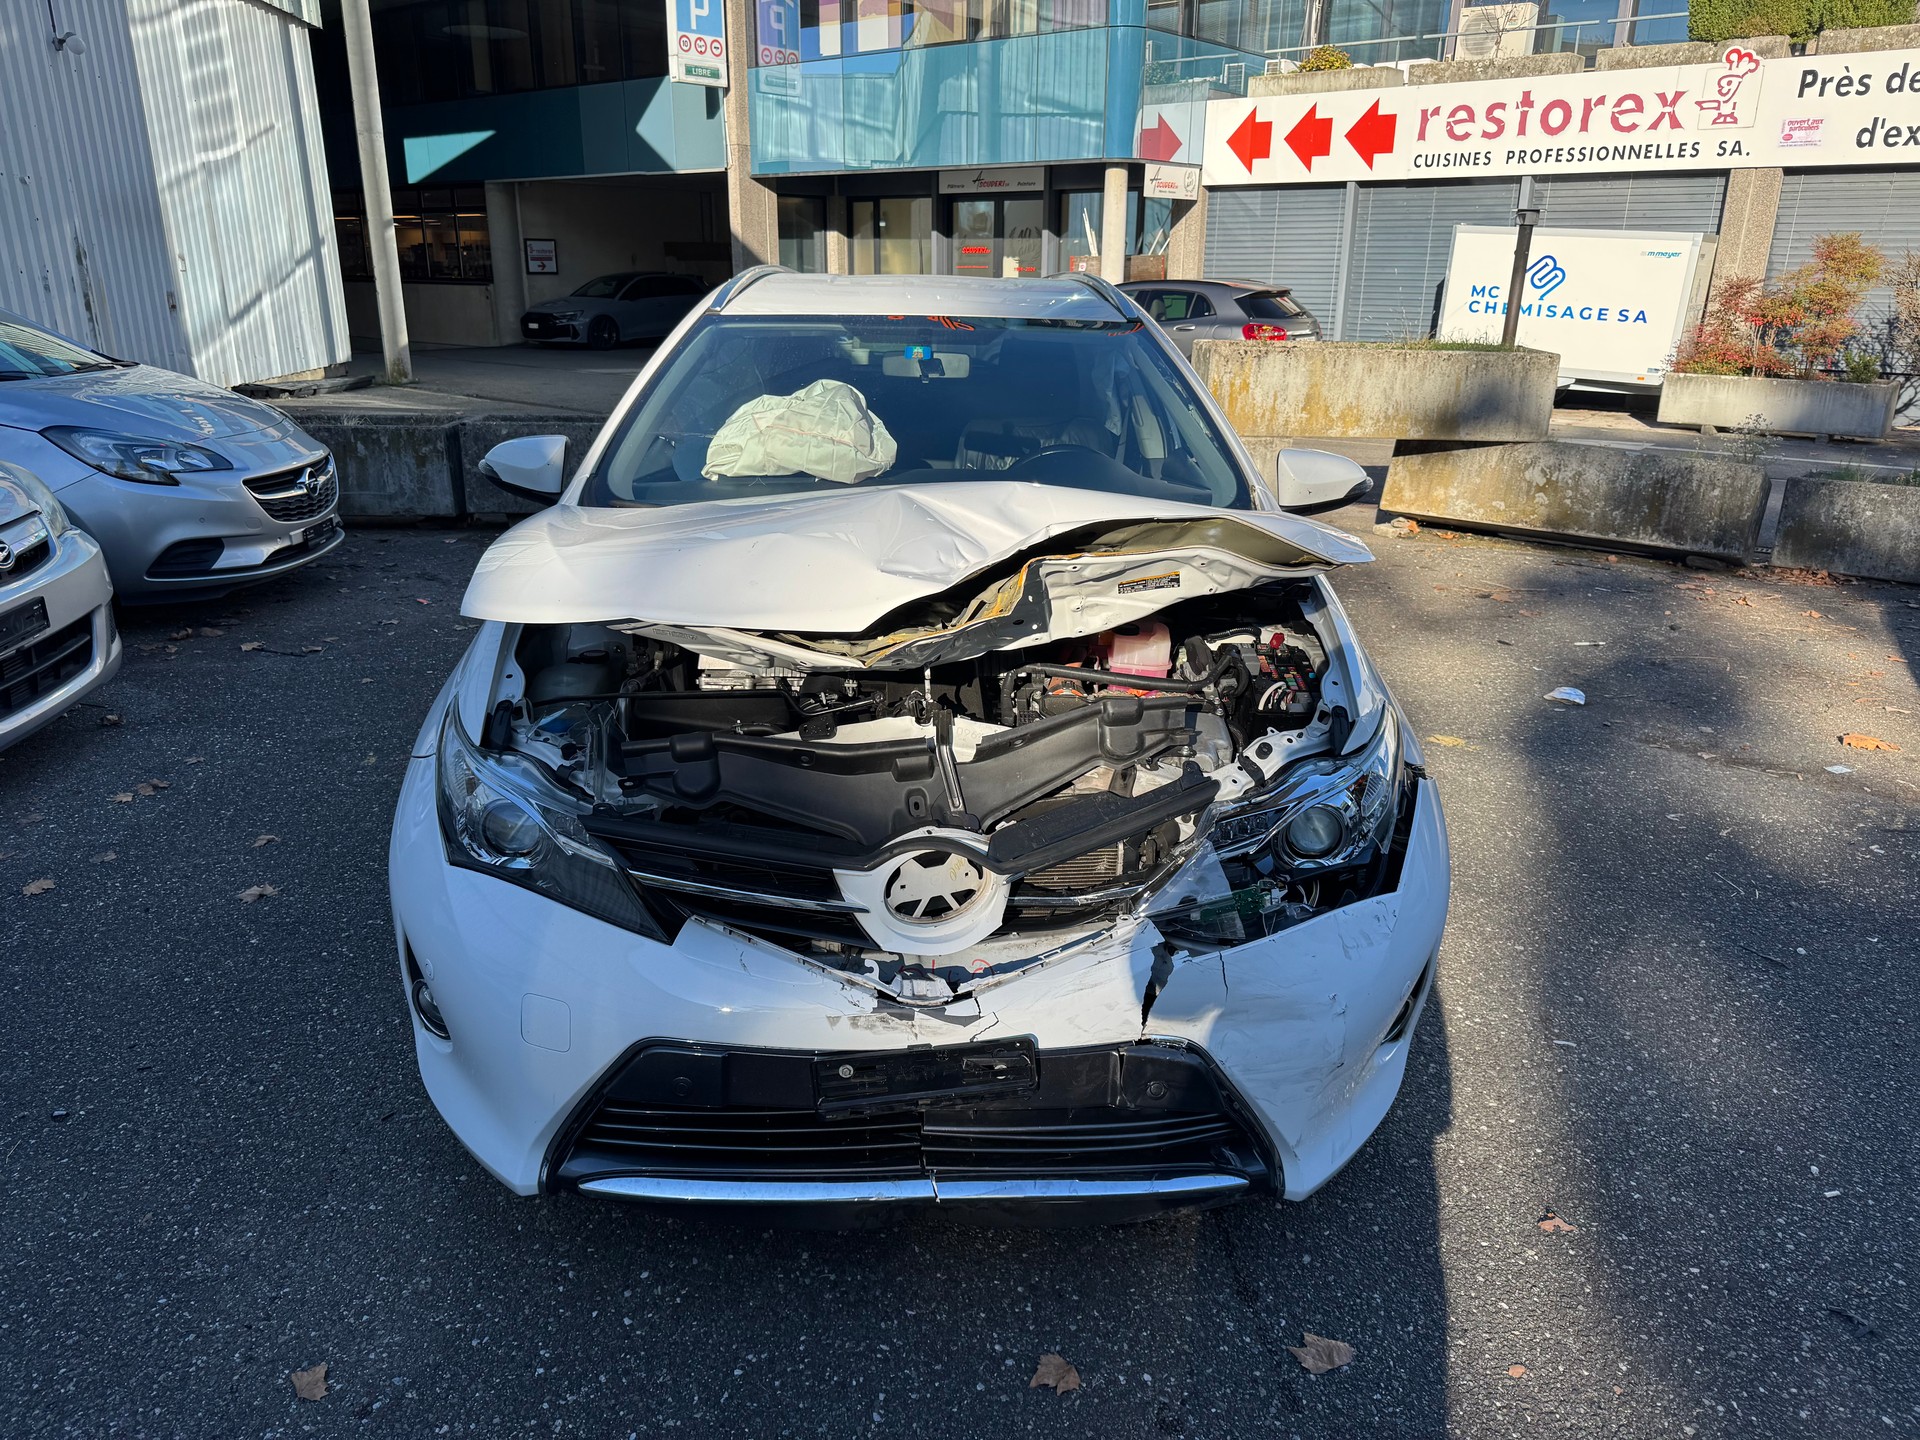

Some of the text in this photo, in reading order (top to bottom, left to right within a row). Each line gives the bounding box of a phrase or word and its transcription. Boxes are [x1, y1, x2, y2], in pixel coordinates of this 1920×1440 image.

[689, 0, 709, 30] P
[682, 40, 689, 48] 10
[692, 67, 712, 77] LIBRE
[1797, 66, 1873, 98] Près
[1416, 90, 1690, 142] restorex
[1787, 118, 1810, 126] ouvert
[1855, 116, 1920, 149] d'ex
[1413, 140, 1751, 169] CUISINES PROFESSIONNELLES SA.
[1470, 285, 1500, 299] MC
[1468, 300, 1648, 324] CHEMISAGE SA
